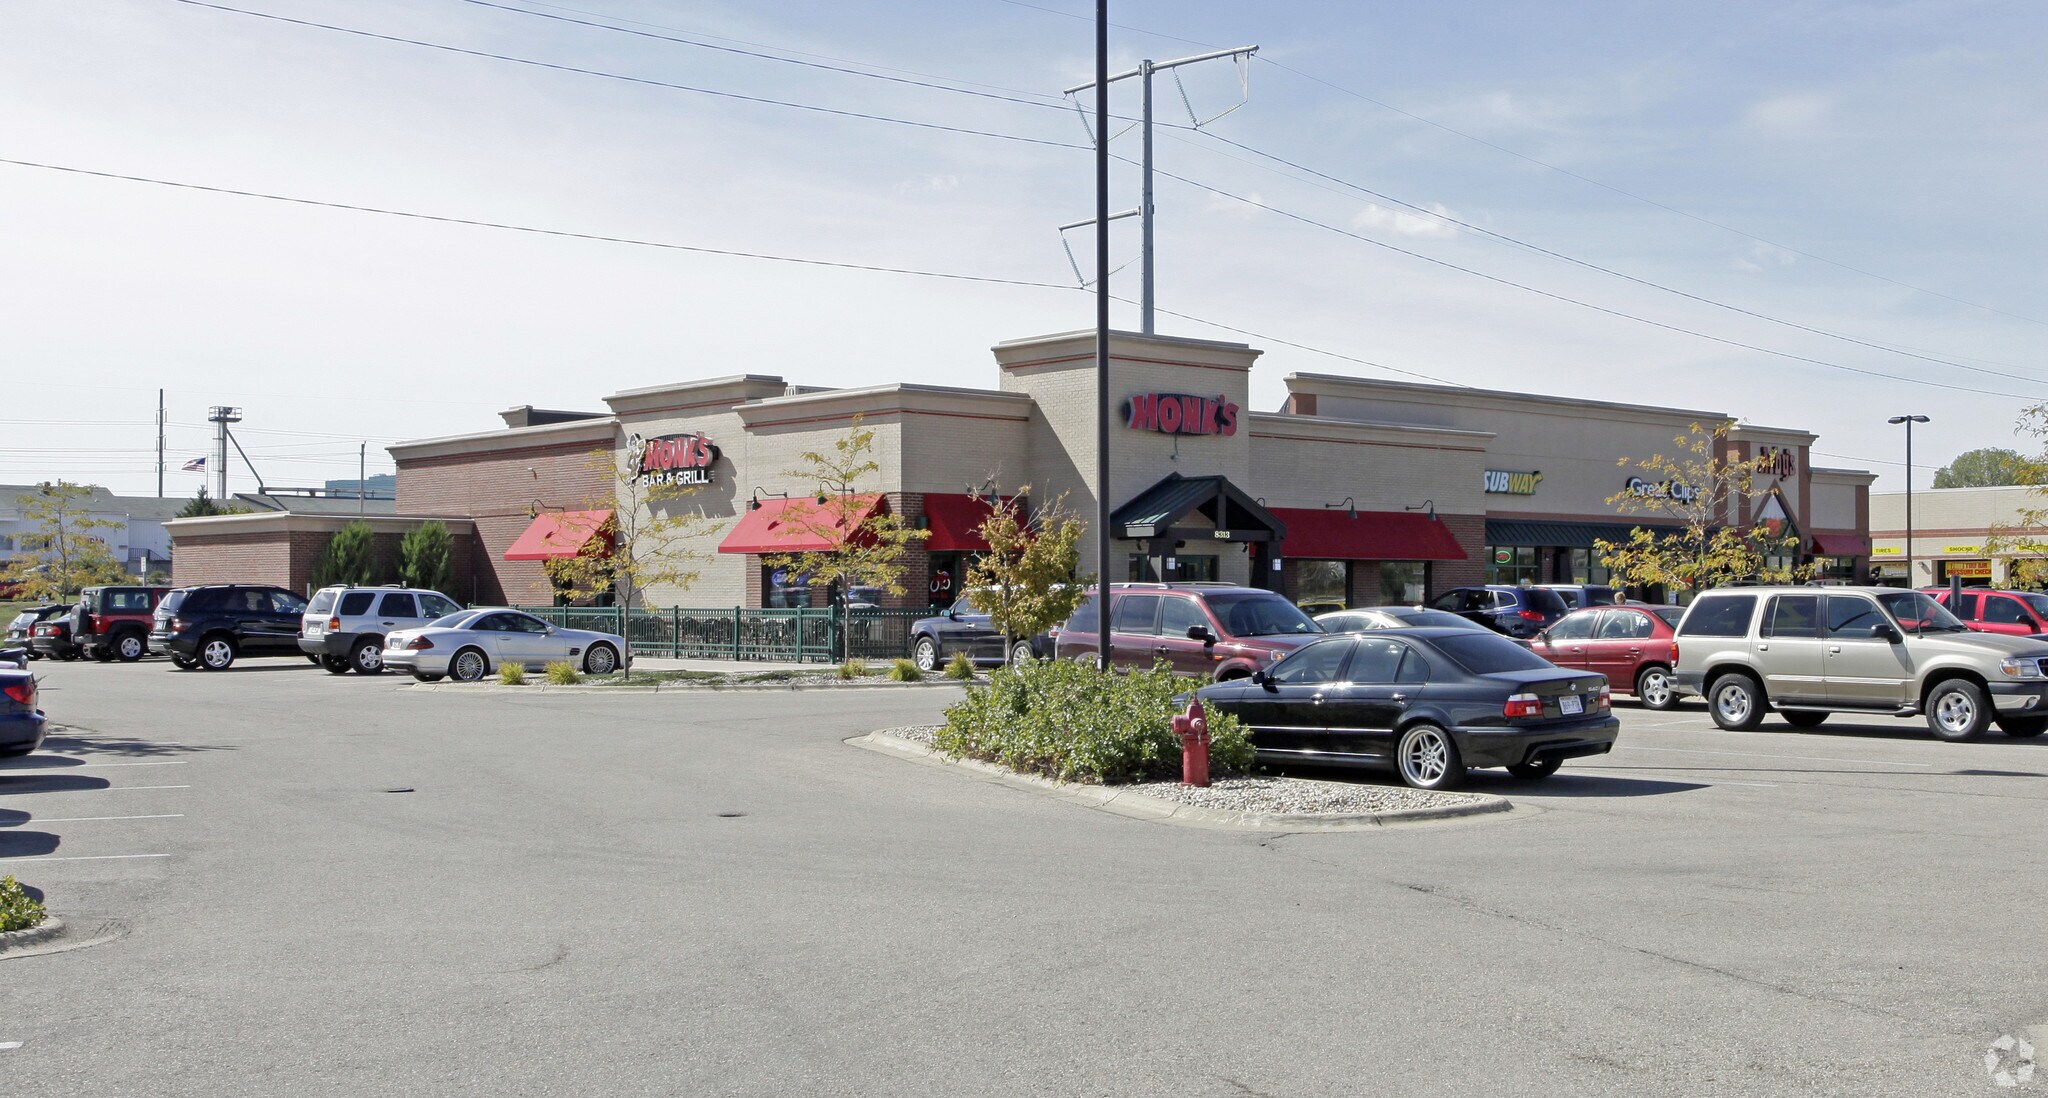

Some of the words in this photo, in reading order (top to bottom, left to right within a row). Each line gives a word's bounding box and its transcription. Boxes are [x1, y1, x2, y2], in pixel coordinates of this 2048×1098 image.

[1129, 392, 1240, 437] MONK'S
[643, 431, 712, 471] MONK'S
[642, 474, 664, 488] BAR
[676, 470, 709, 486] GRILL
[1484, 471, 1543, 494] SUBWAY
[1630, 478, 1669, 498] Grea
[1214, 530, 1231, 539] 8313
